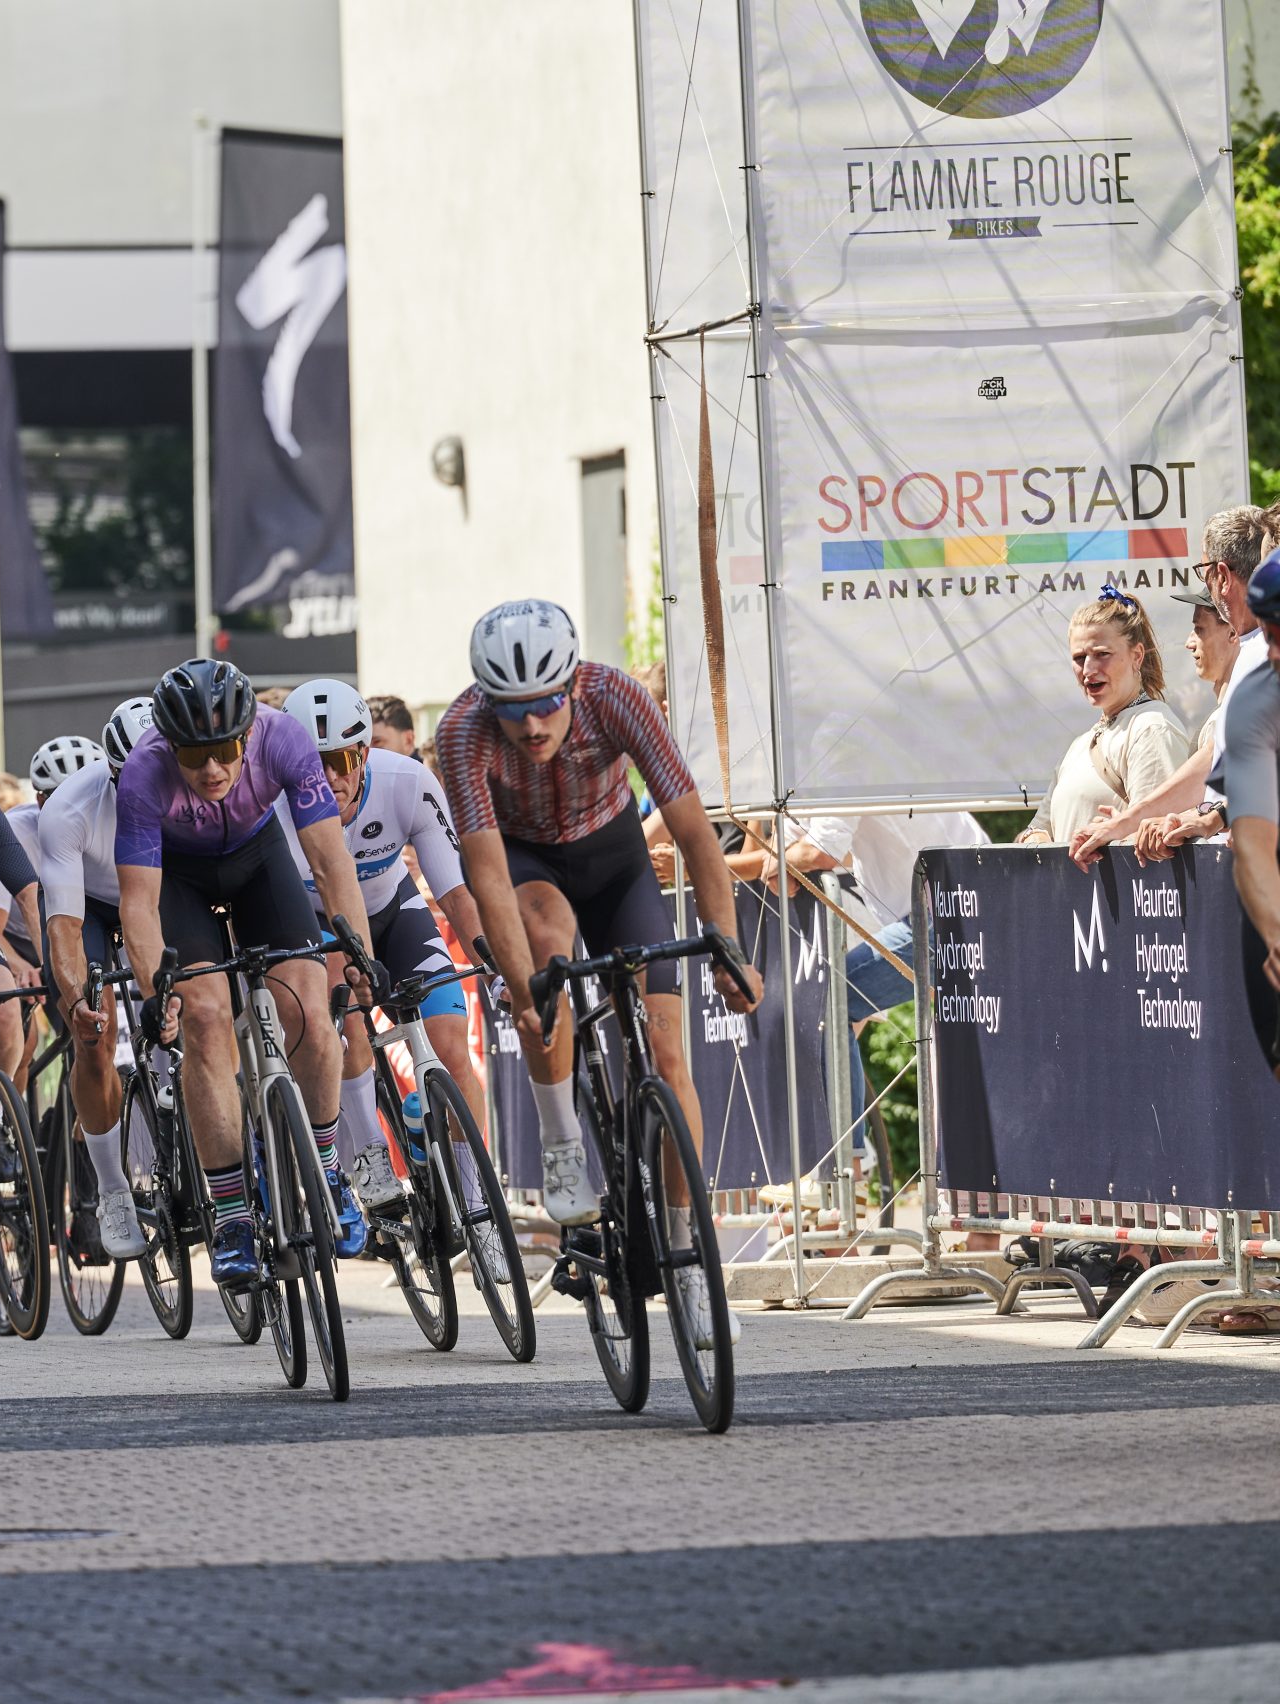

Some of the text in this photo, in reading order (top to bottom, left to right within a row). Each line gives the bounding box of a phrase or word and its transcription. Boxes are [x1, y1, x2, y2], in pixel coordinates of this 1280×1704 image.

[846, 152, 1135, 213] FLAMME ROUGE
[975, 219, 1014, 237] BIKES
[978, 388, 1006, 396] DIRTY
[817, 461, 1196, 534] SPORTSTADT
[821, 567, 1190, 601] FRANKFURT AM MAIN
[933, 880, 979, 918] Maurten
[1131, 878, 1182, 918] Maurten
[935, 931, 986, 980] Hydrogel
[1134, 932, 1189, 983] Hydrogel
[255, 1004, 279, 1059] BMC
[936, 984, 1001, 1034] Technology
[1136, 987, 1202, 1041] Technology
